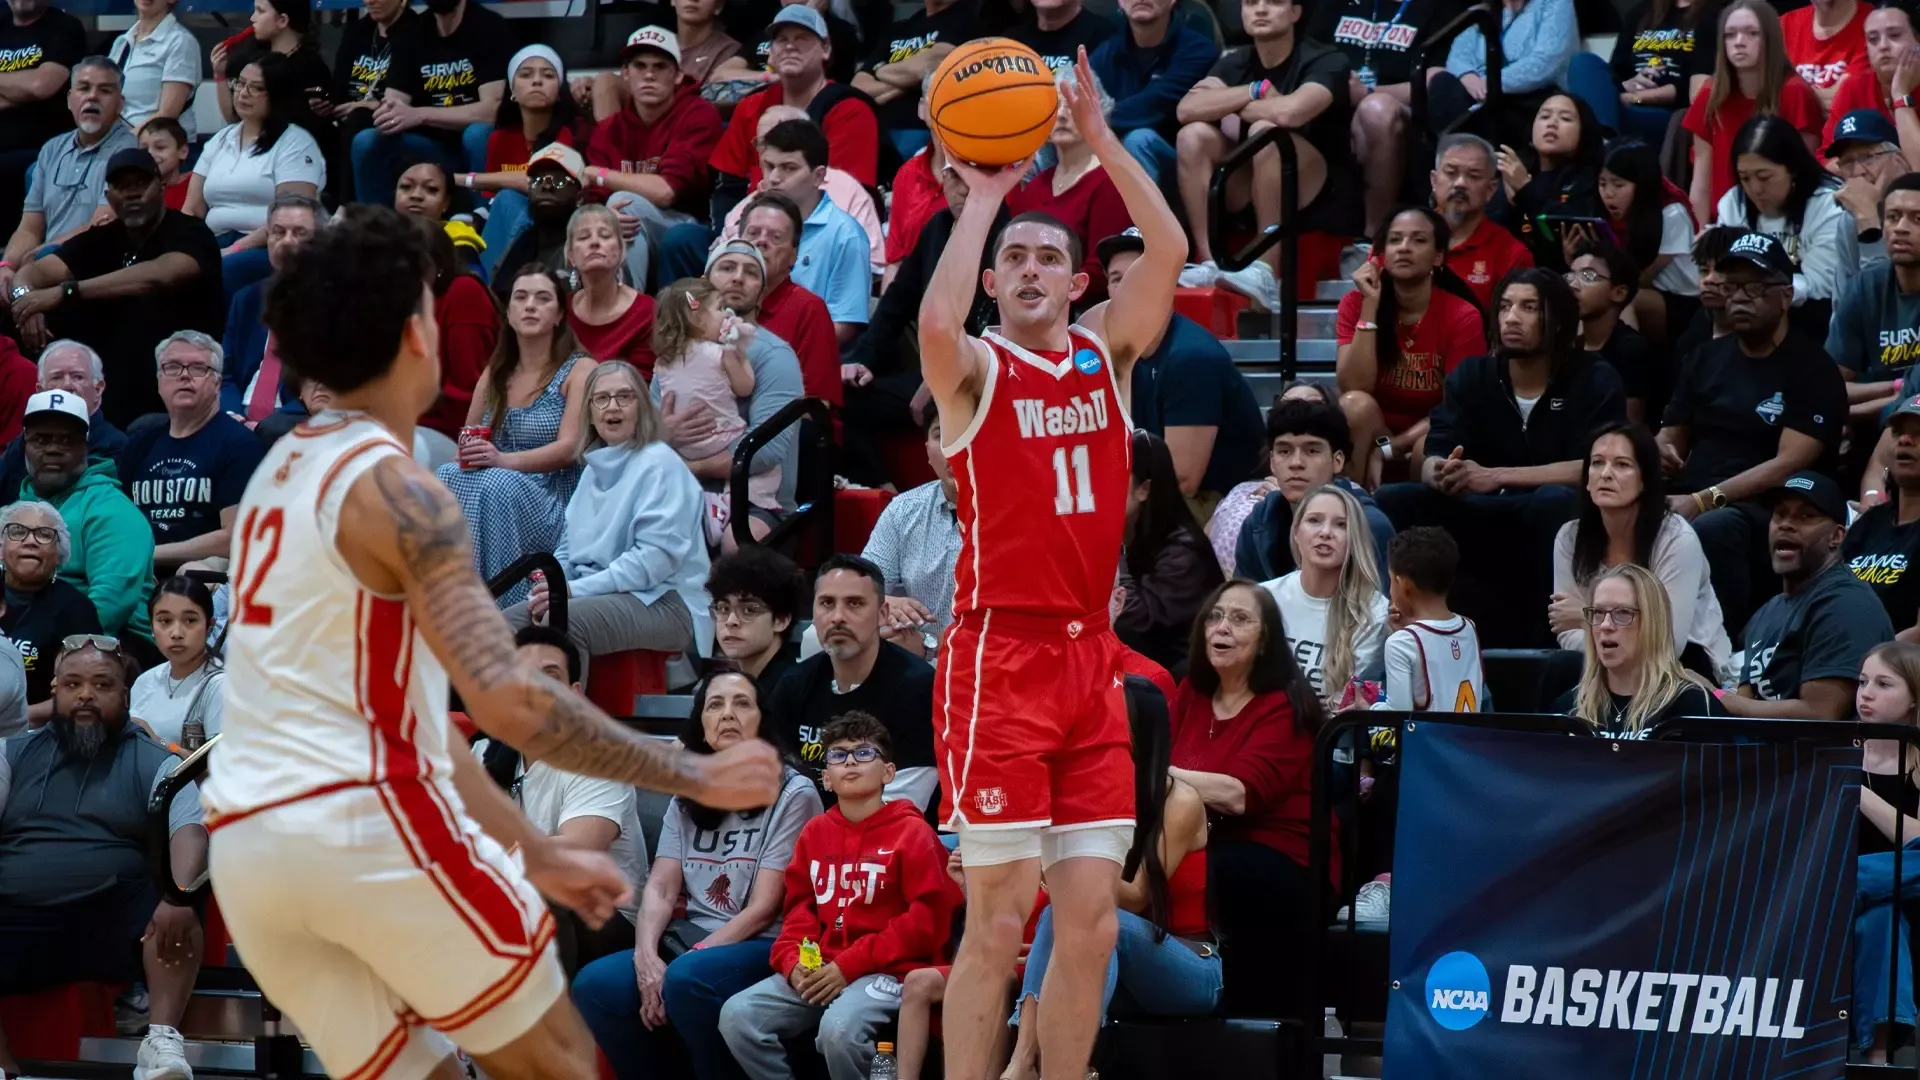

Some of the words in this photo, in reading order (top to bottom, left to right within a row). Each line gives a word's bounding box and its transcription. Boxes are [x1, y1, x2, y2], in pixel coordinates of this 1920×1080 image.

[953, 55, 1040, 83] Wilson
[1729, 233, 1774, 253] ARMY
[1079, 356, 1100, 371] NCAA
[50, 393, 65, 409] P
[1011, 387, 1109, 439] WashU
[132, 477, 212, 506] HOUSTON
[1052, 444, 1096, 516] 11
[150, 507, 186, 520] TEXAS
[229, 504, 285, 627] 12
[692, 826, 761, 857] UST
[809, 859, 887, 908] UST
[1431, 987, 1489, 1012] NCAA
[1500, 964, 1805, 1039] BASKETBALL
